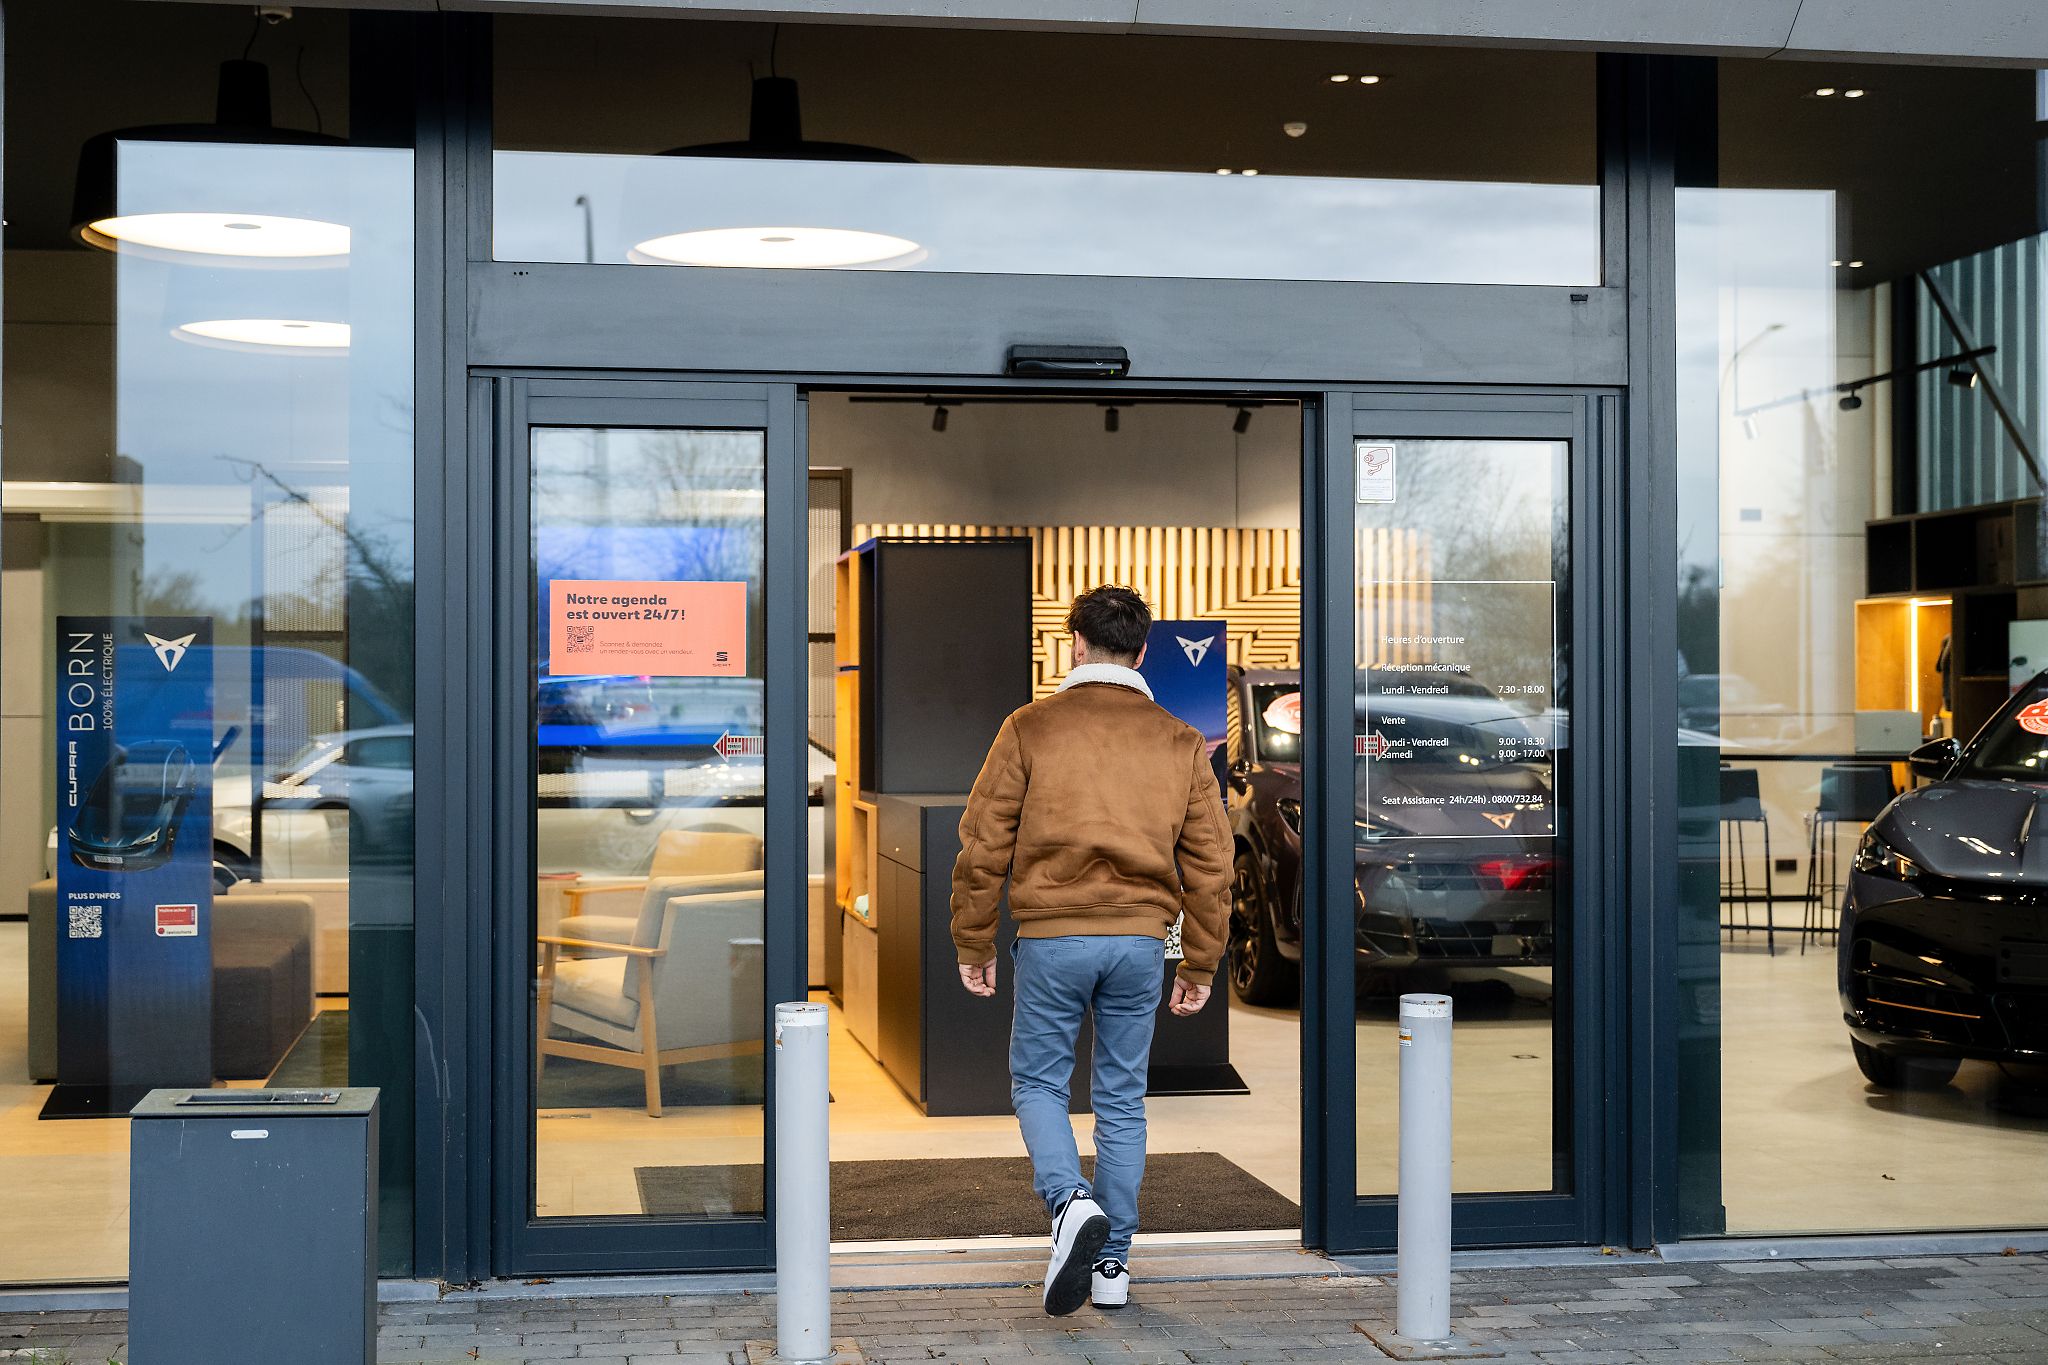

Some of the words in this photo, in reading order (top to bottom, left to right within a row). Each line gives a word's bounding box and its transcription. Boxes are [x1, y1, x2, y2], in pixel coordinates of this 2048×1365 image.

[567, 593, 608, 605] Notre
[611, 594, 667, 608] agenda
[566, 609, 589, 620] est
[592, 610, 640, 620] ouvert
[1381, 635, 1412, 644] Heures
[1414, 635, 1465, 644] d'ouverture
[101, 633, 114, 697] ÉLECTRIQUE
[1381, 663, 1423, 674] Réception
[1424, 663, 1471, 674] mécanique
[68, 633, 95, 731] BORN
[1381, 685, 1405, 694] Lundi
[1411, 685, 1449, 694] Vendredi
[1498, 685, 1515, 694] 7.30
[1523, 685, 1545, 694] 18.00
[102, 700, 113, 730] 100%
[1381, 716, 1406, 725] Vente
[1382, 737, 1405, 747] Lundi
[1412, 737, 1449, 747] Vendredi
[1498, 737, 1516, 746] 9.00
[1523, 737, 1545, 746] 18.30
[1381, 749, 1413, 759] Samedi
[1498, 749, 1516, 758] 9.00
[1523, 749, 1545, 758] 17.00
[68, 741, 78, 807] CUPRA
[1382, 796, 1400, 805] Seat
[1402, 796, 1445, 805] Assistance
[68, 892, 88, 900] PLUS
[89, 892, 121, 900] D'INFOS
